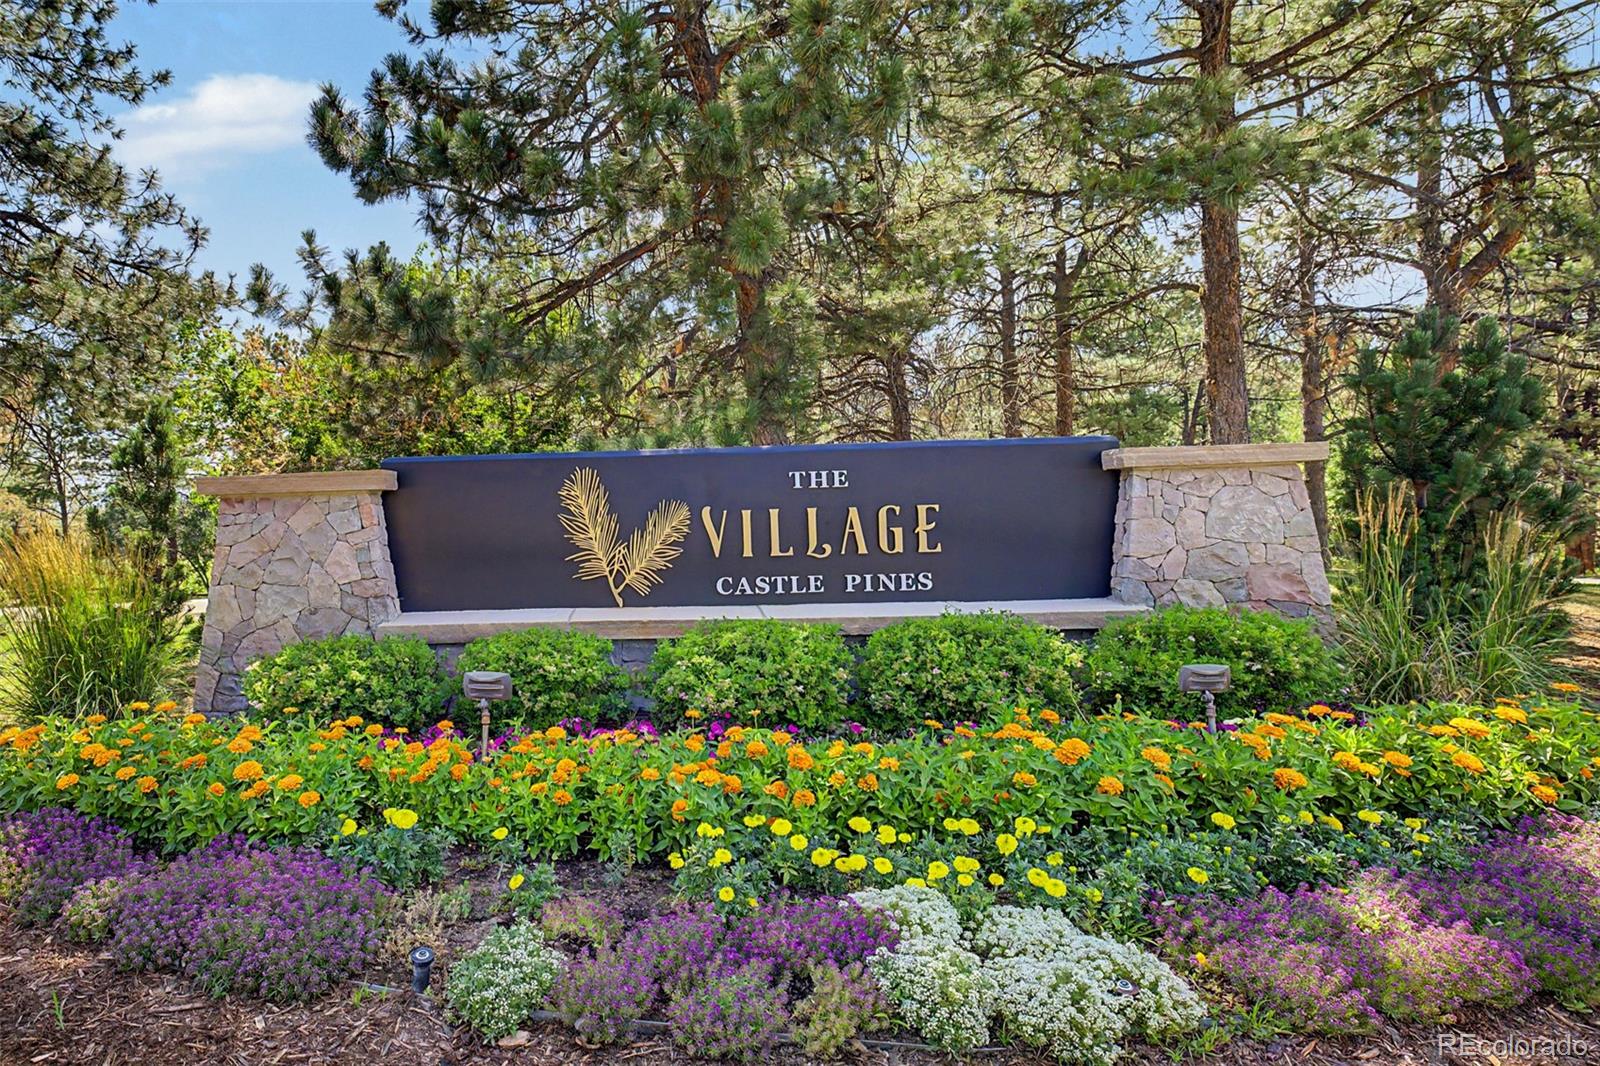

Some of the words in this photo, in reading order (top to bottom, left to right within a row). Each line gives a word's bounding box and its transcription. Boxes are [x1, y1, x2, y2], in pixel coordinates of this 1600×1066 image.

[788, 469, 849, 489] THE
[701, 504, 942, 559] VILLAGE
[716, 574, 825, 595] CASTLE
[844, 572, 934, 593] PINES
